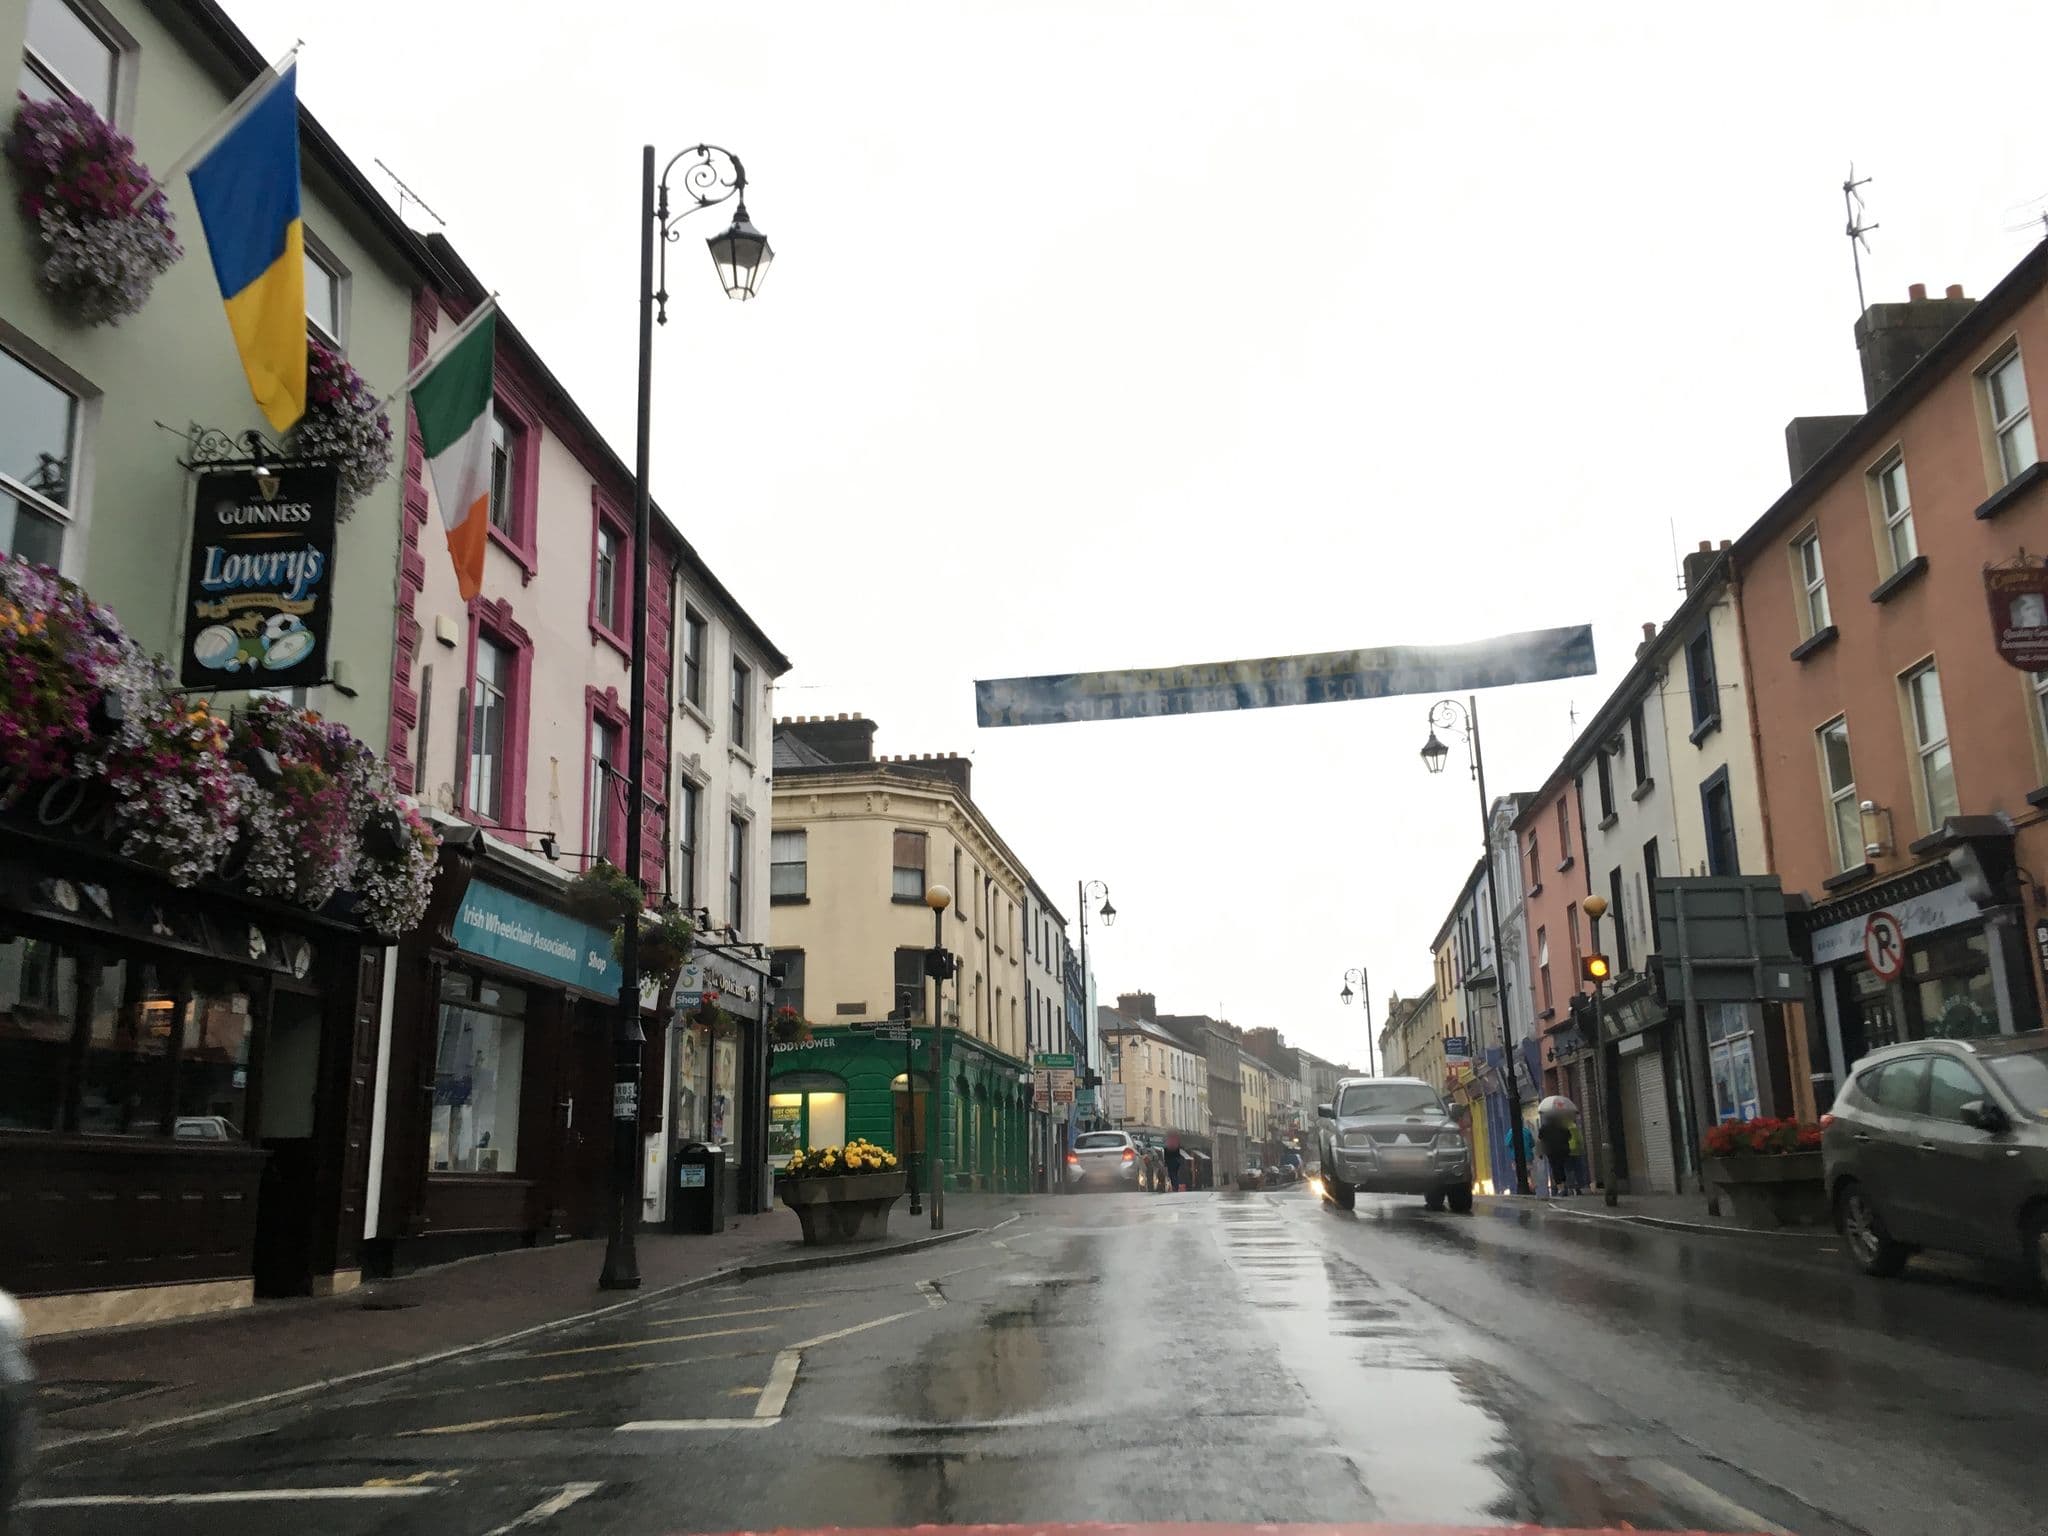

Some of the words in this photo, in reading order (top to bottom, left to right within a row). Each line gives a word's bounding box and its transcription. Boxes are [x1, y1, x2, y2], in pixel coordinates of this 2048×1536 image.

[218, 503, 311, 525] GUINNESS
[463, 904, 485, 930] Irish
[485, 911, 534, 948] Wheelchair
[533, 932, 577, 963] Association
[588, 950, 607, 975] Shop
[676, 994, 700, 1006] Shop
